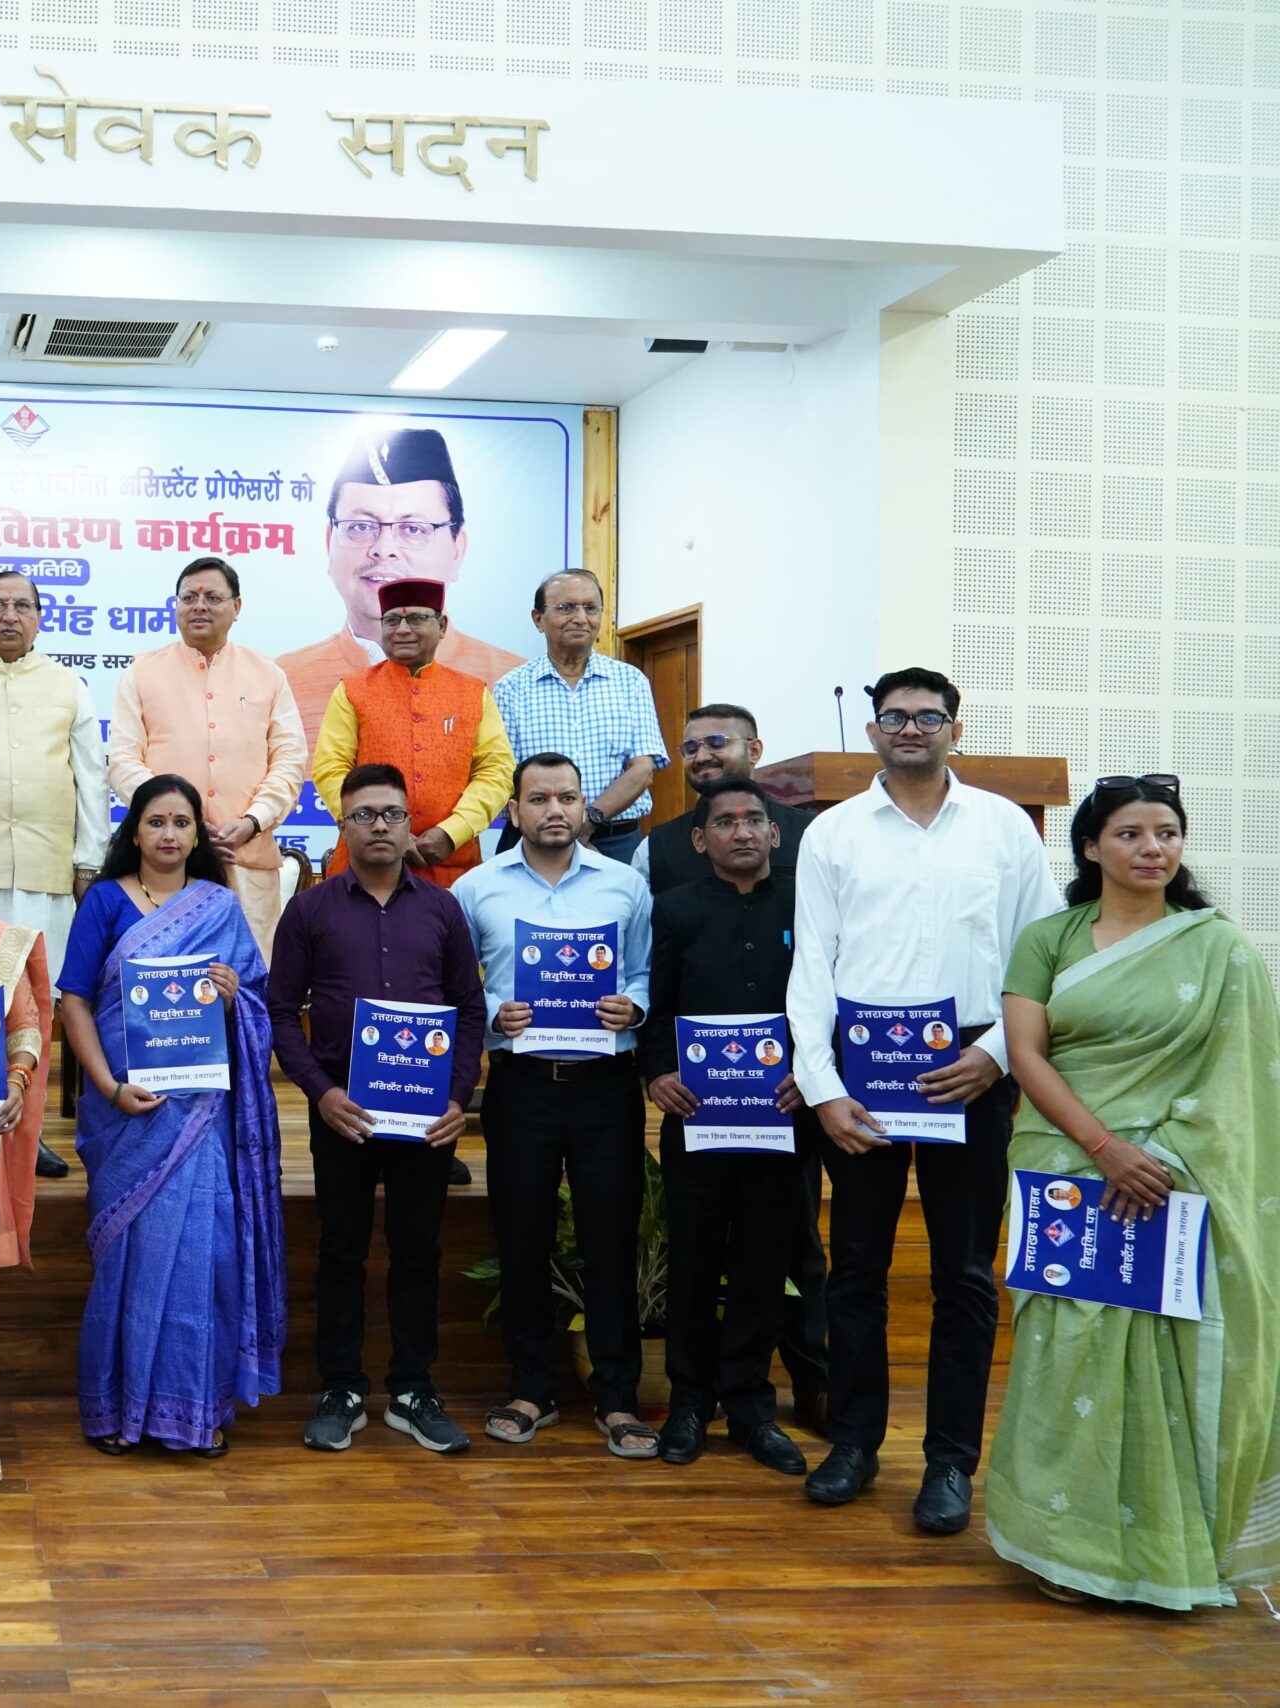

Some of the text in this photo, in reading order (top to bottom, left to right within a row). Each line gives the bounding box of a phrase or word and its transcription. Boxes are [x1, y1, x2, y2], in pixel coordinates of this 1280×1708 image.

[326, 108, 551, 192] सदन
[119, 465, 199, 499] असिस्टेंट
[205, 468, 283, 502] प्रोफेसरों
[290, 472, 317, 503] को
[135, 510, 297, 557] कार्यक्रम
[20, 559, 83, 578] अतिथि
[531, 932, 605, 941] उत्तराखण्ड शासन
[137, 968, 209, 979] उत्तराखण्ड शासन
[541, 970, 594, 982] नियुक्ति पत्र
[533, 998, 567, 1008] असिस्टेंट
[150, 1008, 202, 1020] नियुक्ति पत्र
[371, 1012, 444, 1027] उत्तराखण्ड शासन
[856, 1010, 941, 1019] उत्तराखण्ड शासन
[694, 1028, 773, 1038] उत्तराखण्ड शासन
[145, 1036, 211, 1048] असिस्टेंट प्रोफेसर
[378, 1052, 430, 1066] नियुक्ति पत्र
[871, 1051, 933, 1063] नियुक्ति पत्र
[708, 1068, 765, 1080] नियुक्ति पत्र
[368, 1080, 434, 1095] असिस्टेंट प्रोफेसर
[866, 1080, 905, 1091] असिस्टेंट
[703, 1096, 774, 1106] असिस्टेंट प्रोफेसर
[1025, 1185, 1041, 1272] उत्तराखण्ड शासन
[1079, 1206, 1097, 1270] नियुक्ति पत्र
[1119, 1243, 1135, 1284] असिस्टेंट
